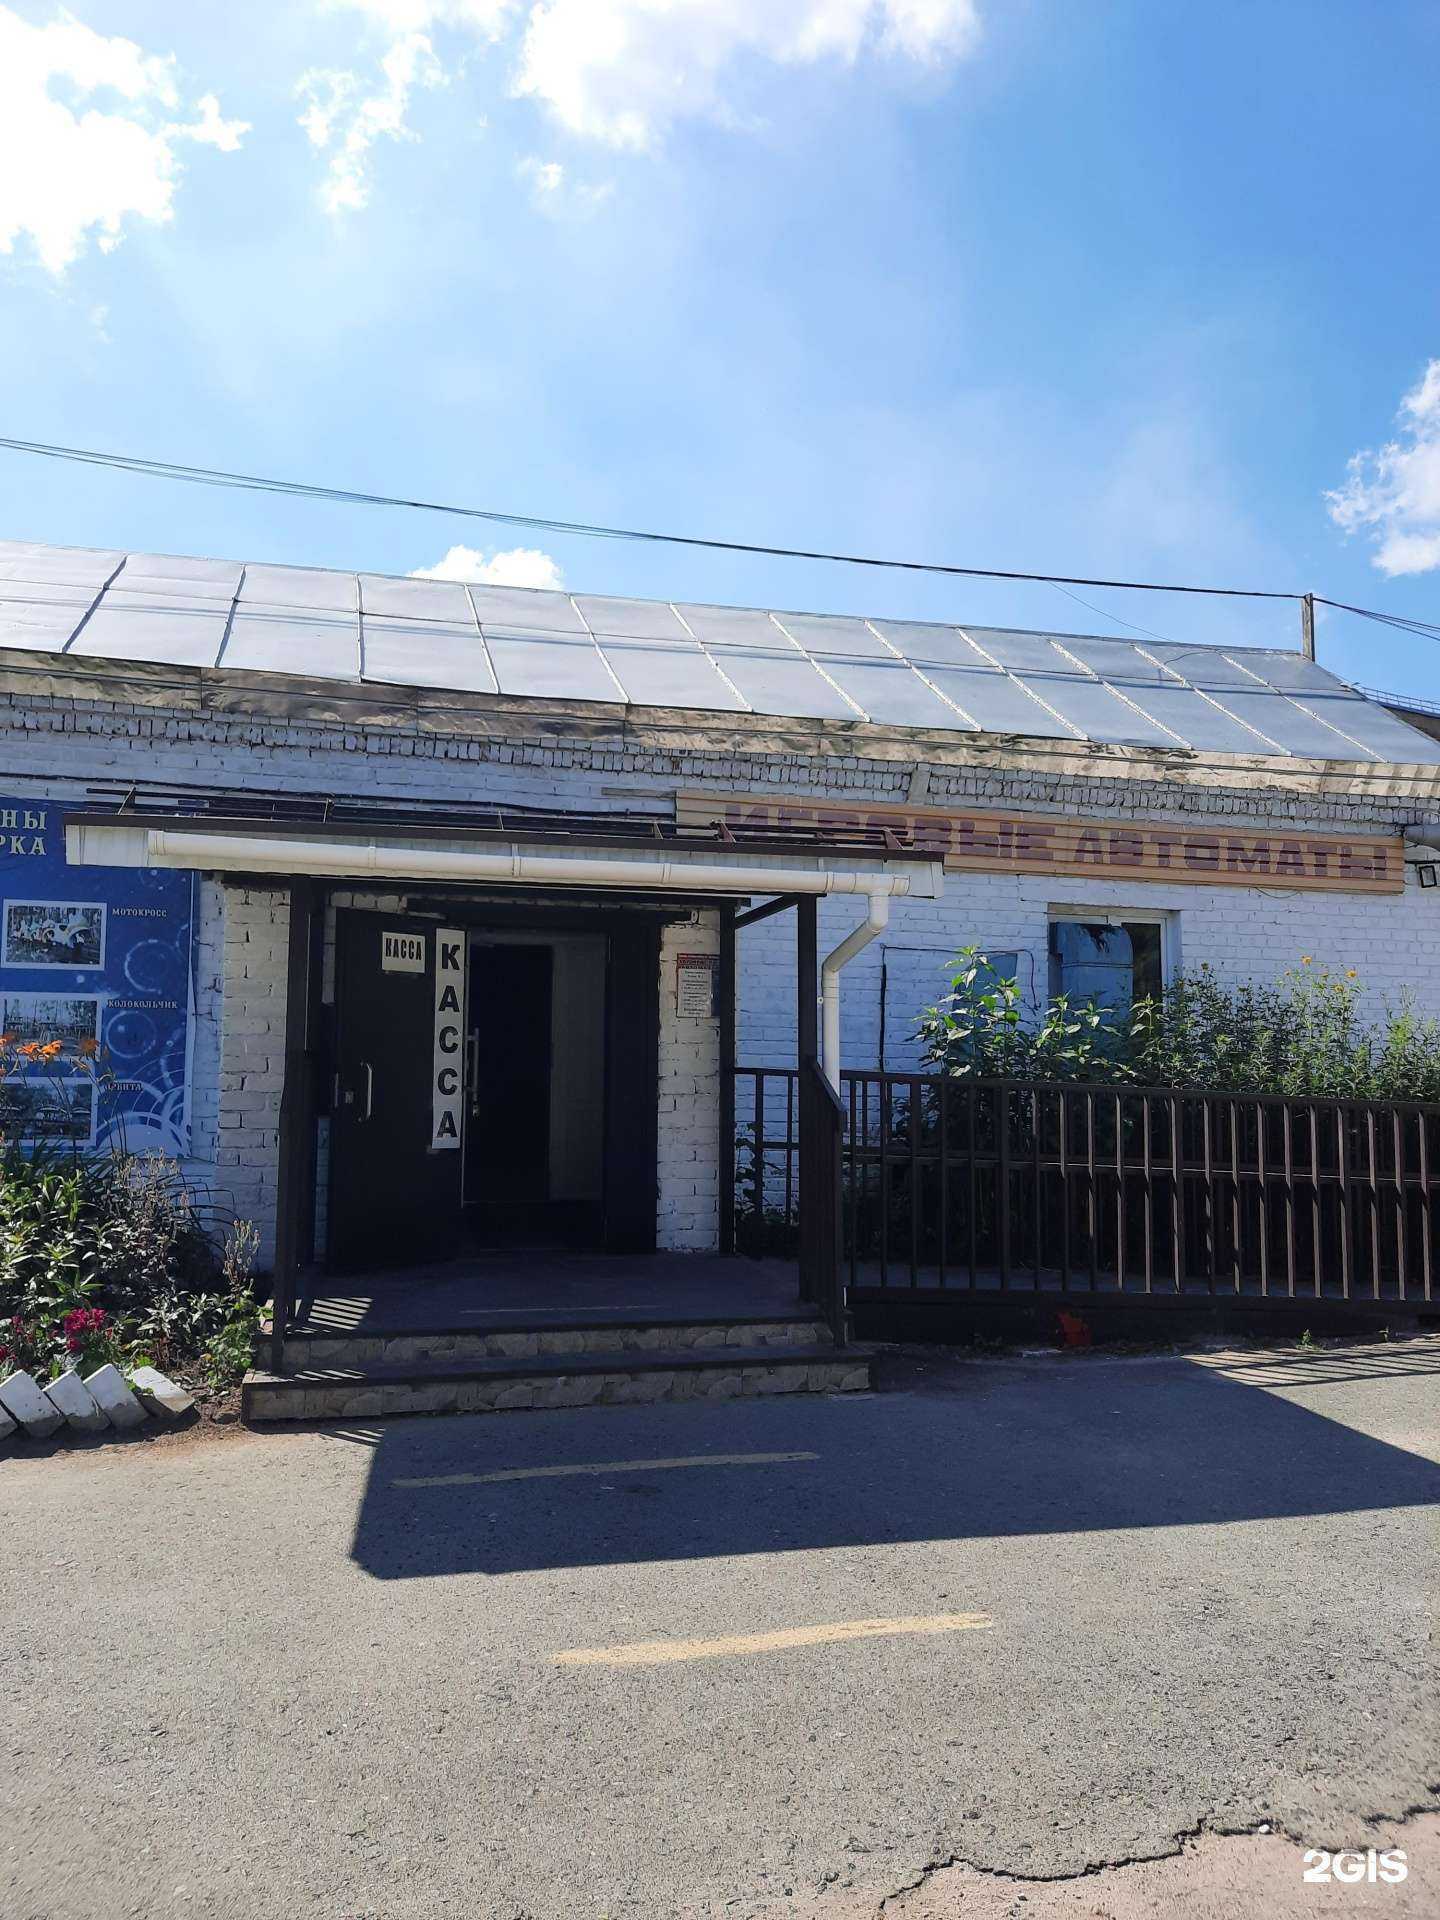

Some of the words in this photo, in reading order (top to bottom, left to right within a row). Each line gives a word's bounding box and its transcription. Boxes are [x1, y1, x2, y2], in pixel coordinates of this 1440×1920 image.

[1073, 828, 1389, 881] АВТОМАТЫ
[112, 908, 168, 917] МОТОКРОСС
[385, 938, 422, 960] КАССА
[108, 1000, 178, 1009] КОЛОКОЛЬЧИК
[437, 943, 461, 1139] КАССА
